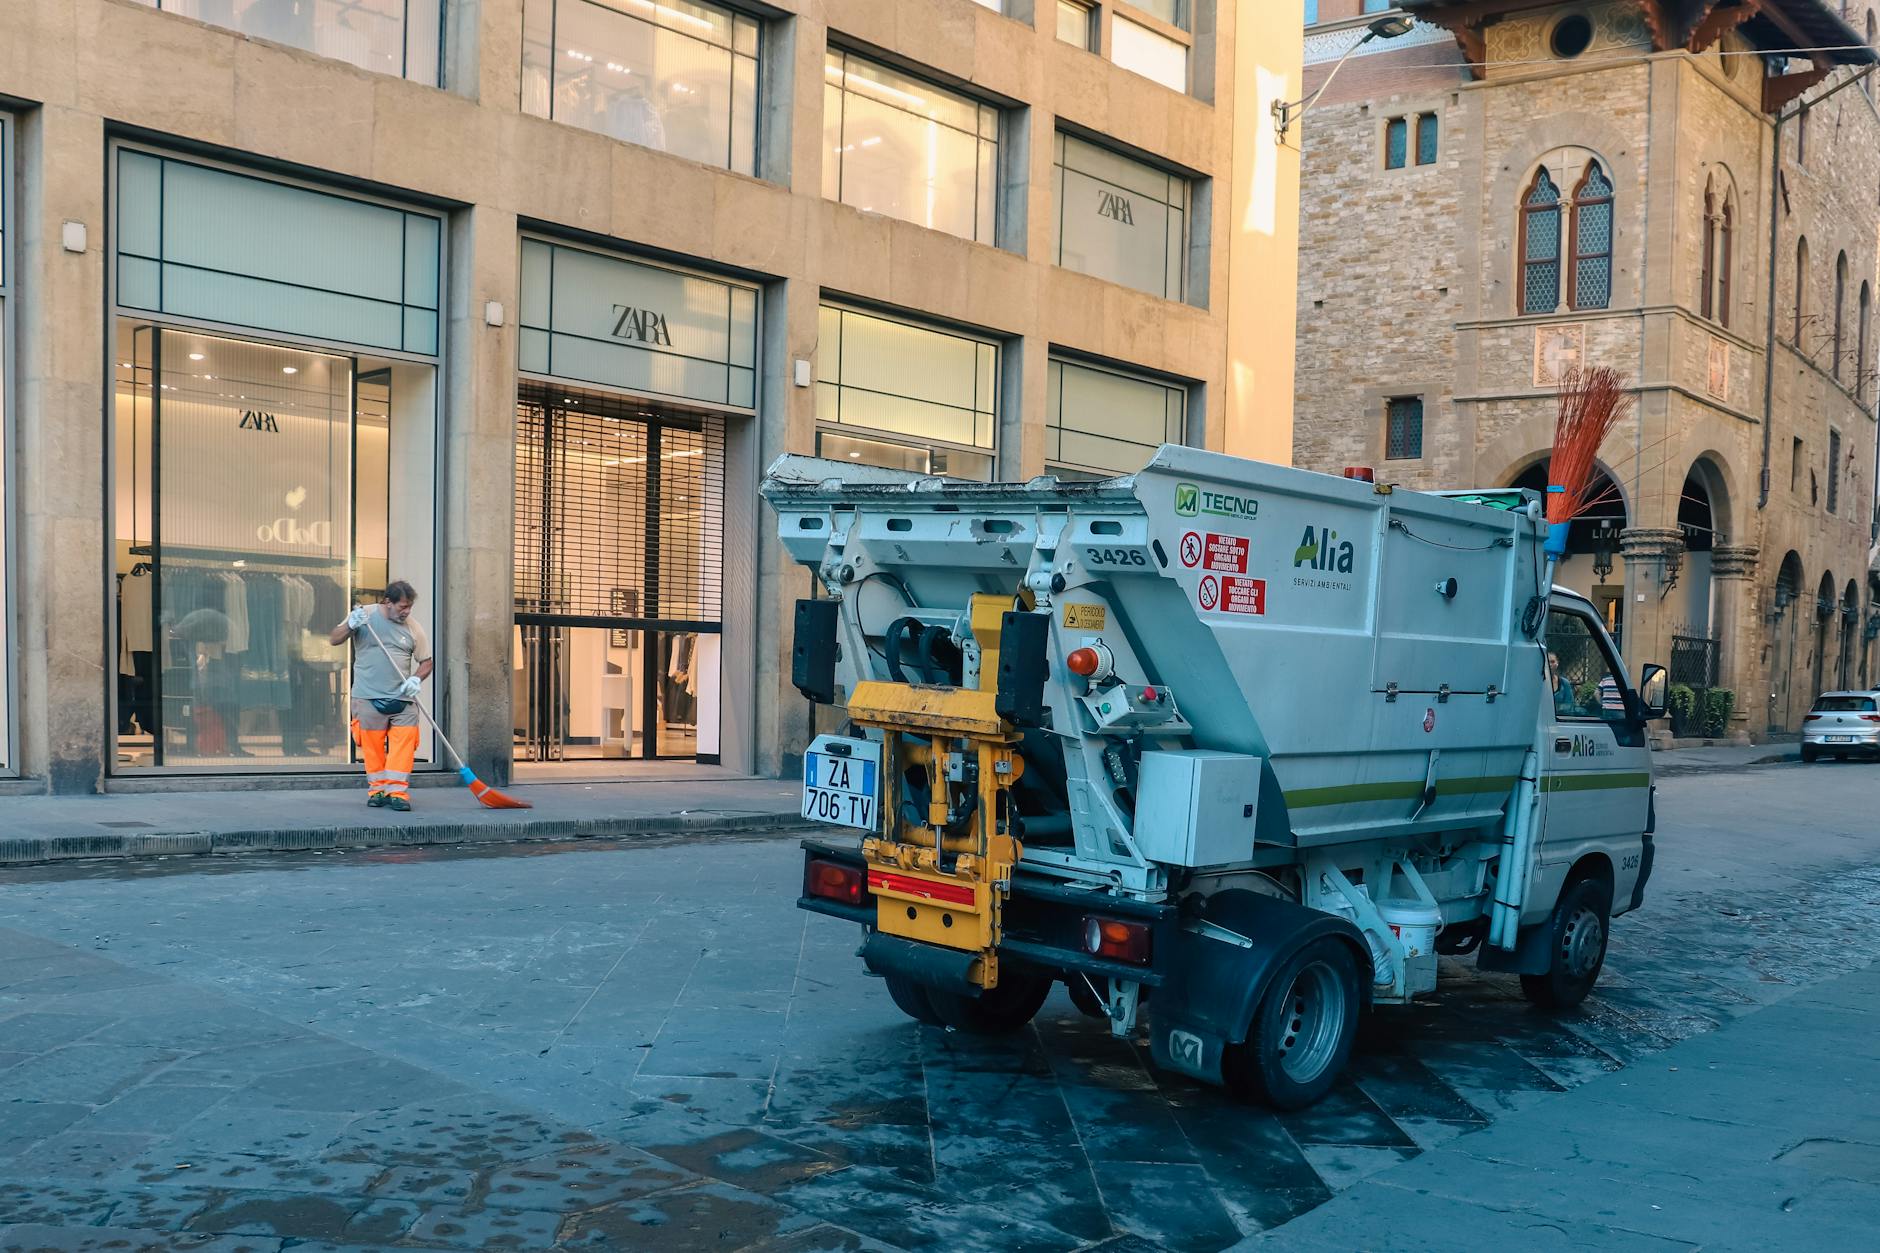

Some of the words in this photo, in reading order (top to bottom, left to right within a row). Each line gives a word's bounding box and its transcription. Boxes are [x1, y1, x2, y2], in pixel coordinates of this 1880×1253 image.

[1098, 190, 1134, 226] ZARA
[612, 304, 674, 347] ZARA
[239, 409, 279, 433] ZARA
[1202, 491, 1258, 515] TECNO
[1218, 536, 1237, 546] VIETATO
[1294, 525, 1353, 573] Alia
[1087, 548, 1146, 566] 3426
[1234, 578, 1254, 588] VIETATO
[1293, 577, 1316, 587] SERVIZI
[1572, 733, 1595, 757] Alia
[828, 759, 850, 789] ZA
[807, 788, 840, 820] 706
[848, 795, 871, 826] TV
[1622, 855, 1639, 871] 3426
